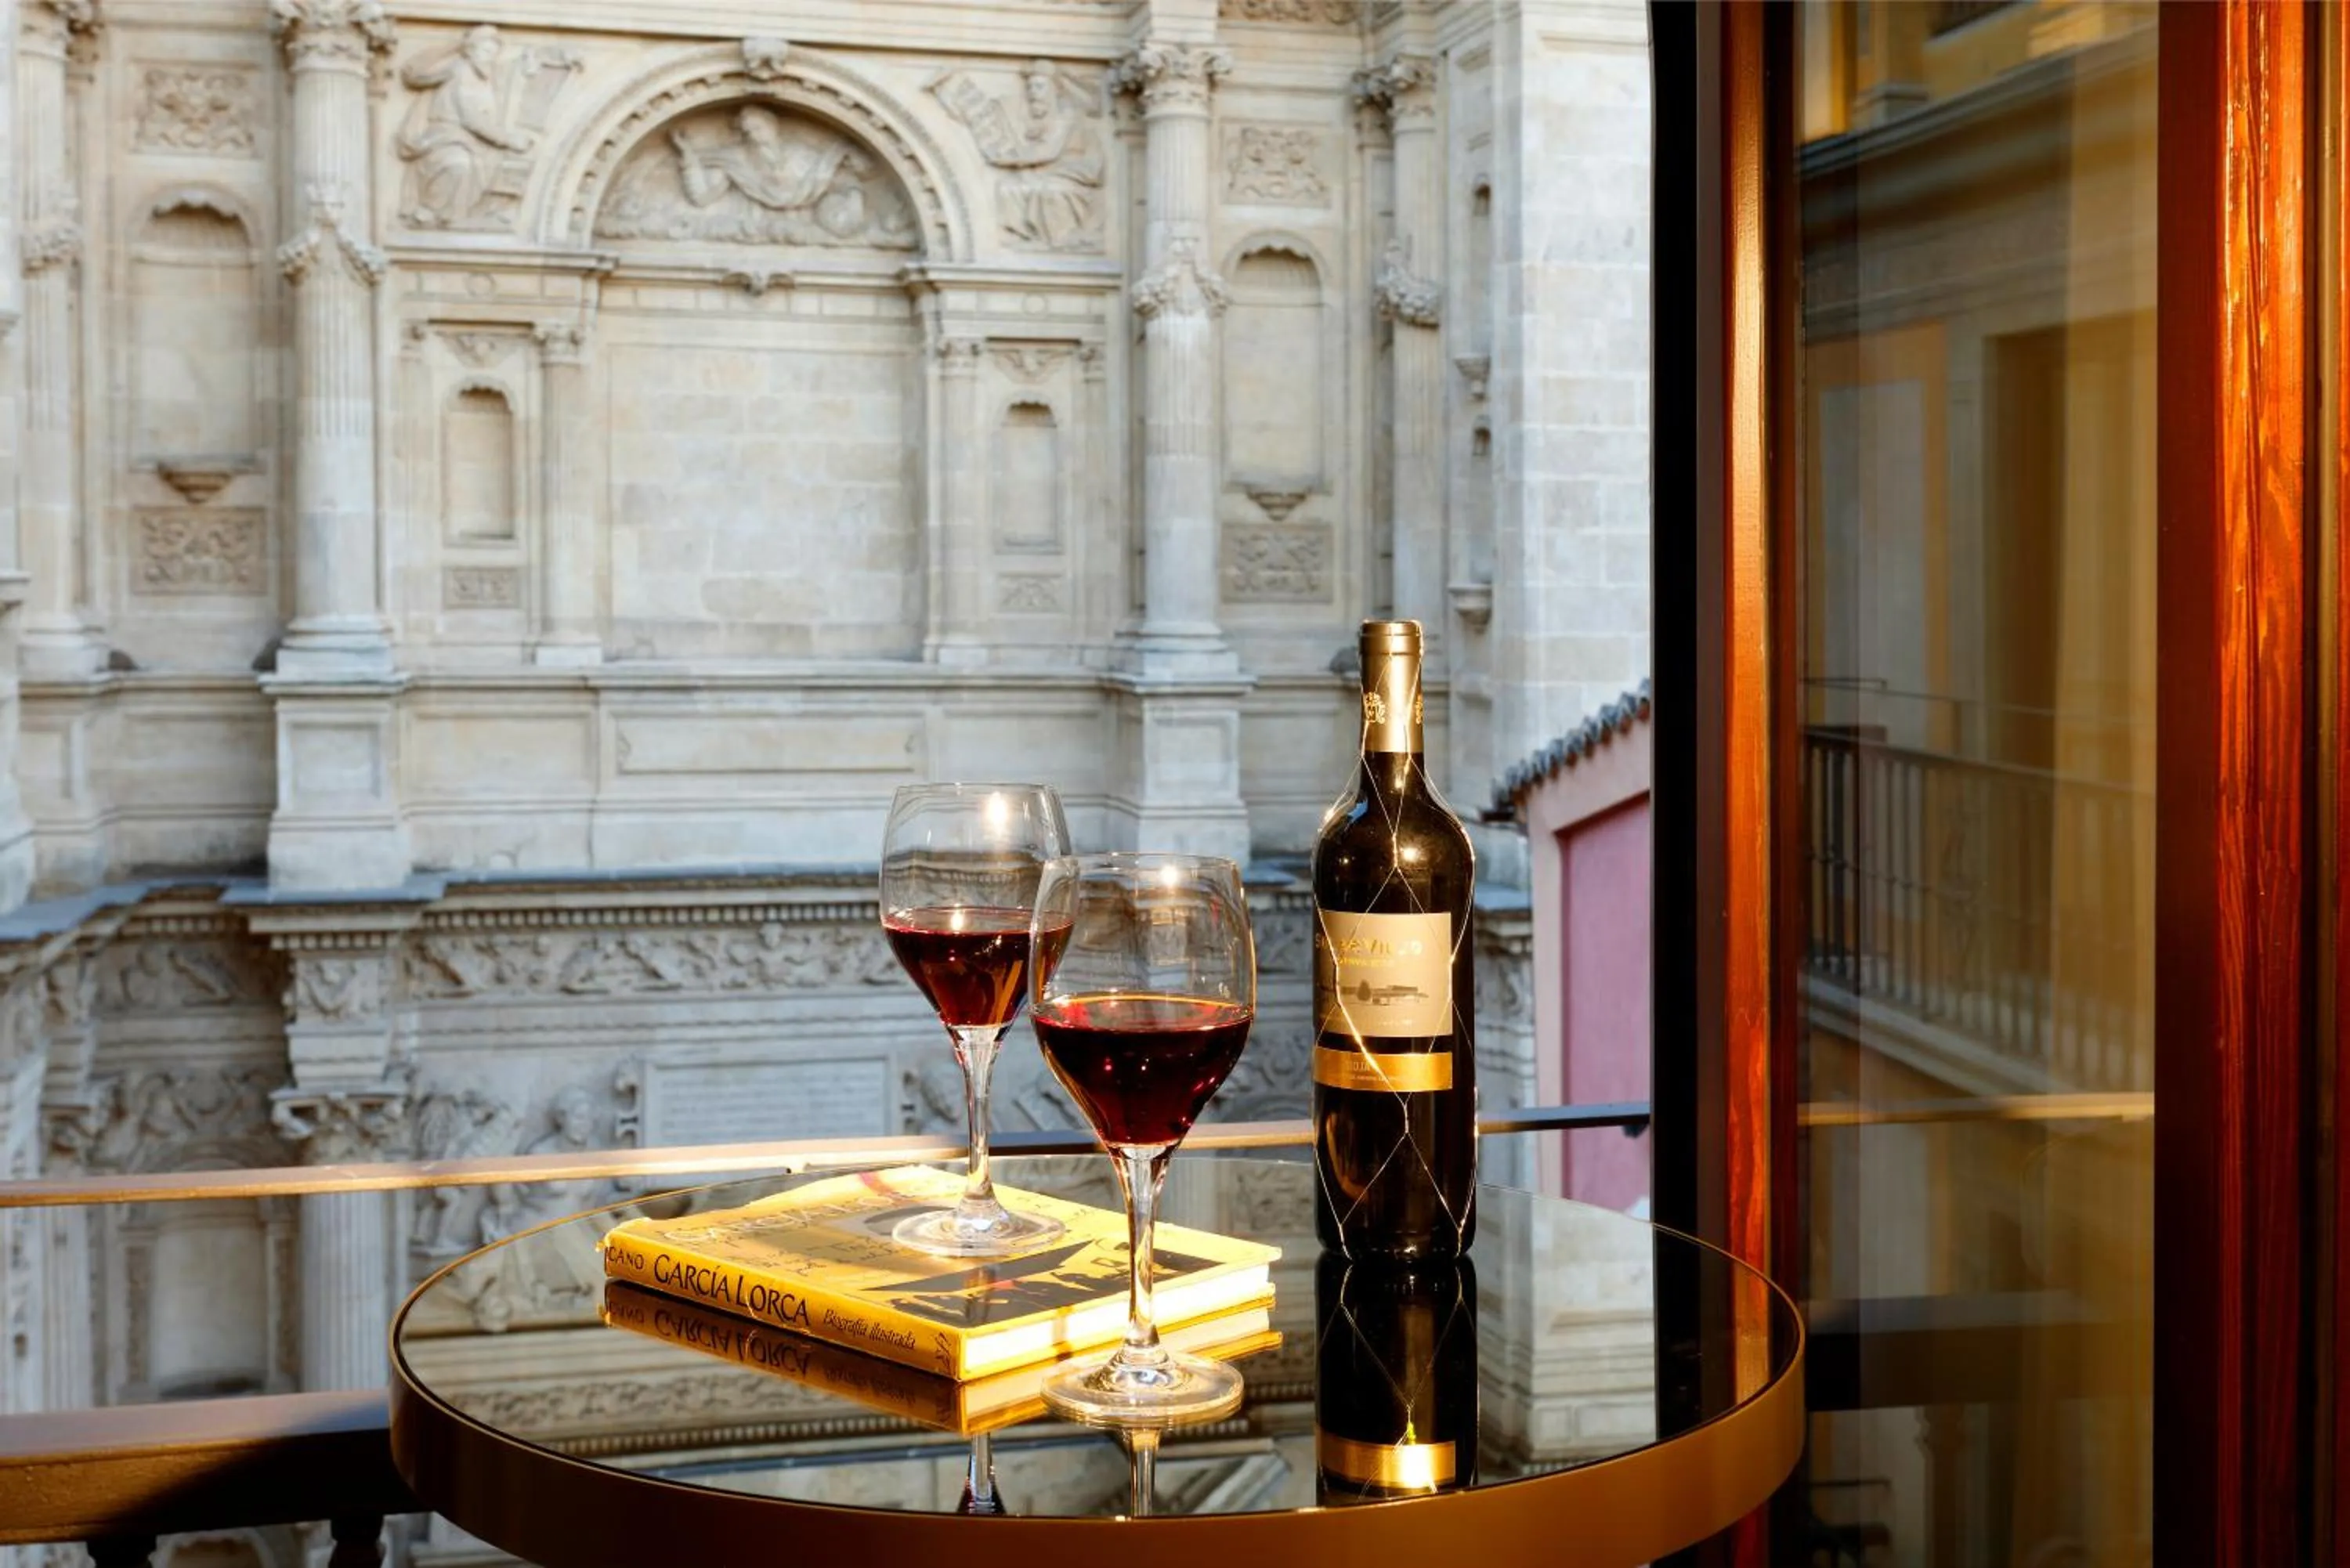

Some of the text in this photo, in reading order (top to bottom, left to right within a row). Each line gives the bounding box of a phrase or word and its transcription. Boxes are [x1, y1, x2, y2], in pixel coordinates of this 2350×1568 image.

[607, 1246, 644, 1270] CANO
[654, 1254, 730, 1302] GARCÍA
[736, 1275, 811, 1326] LORCA
[824, 1309, 916, 1349] Biografía ilustrada
